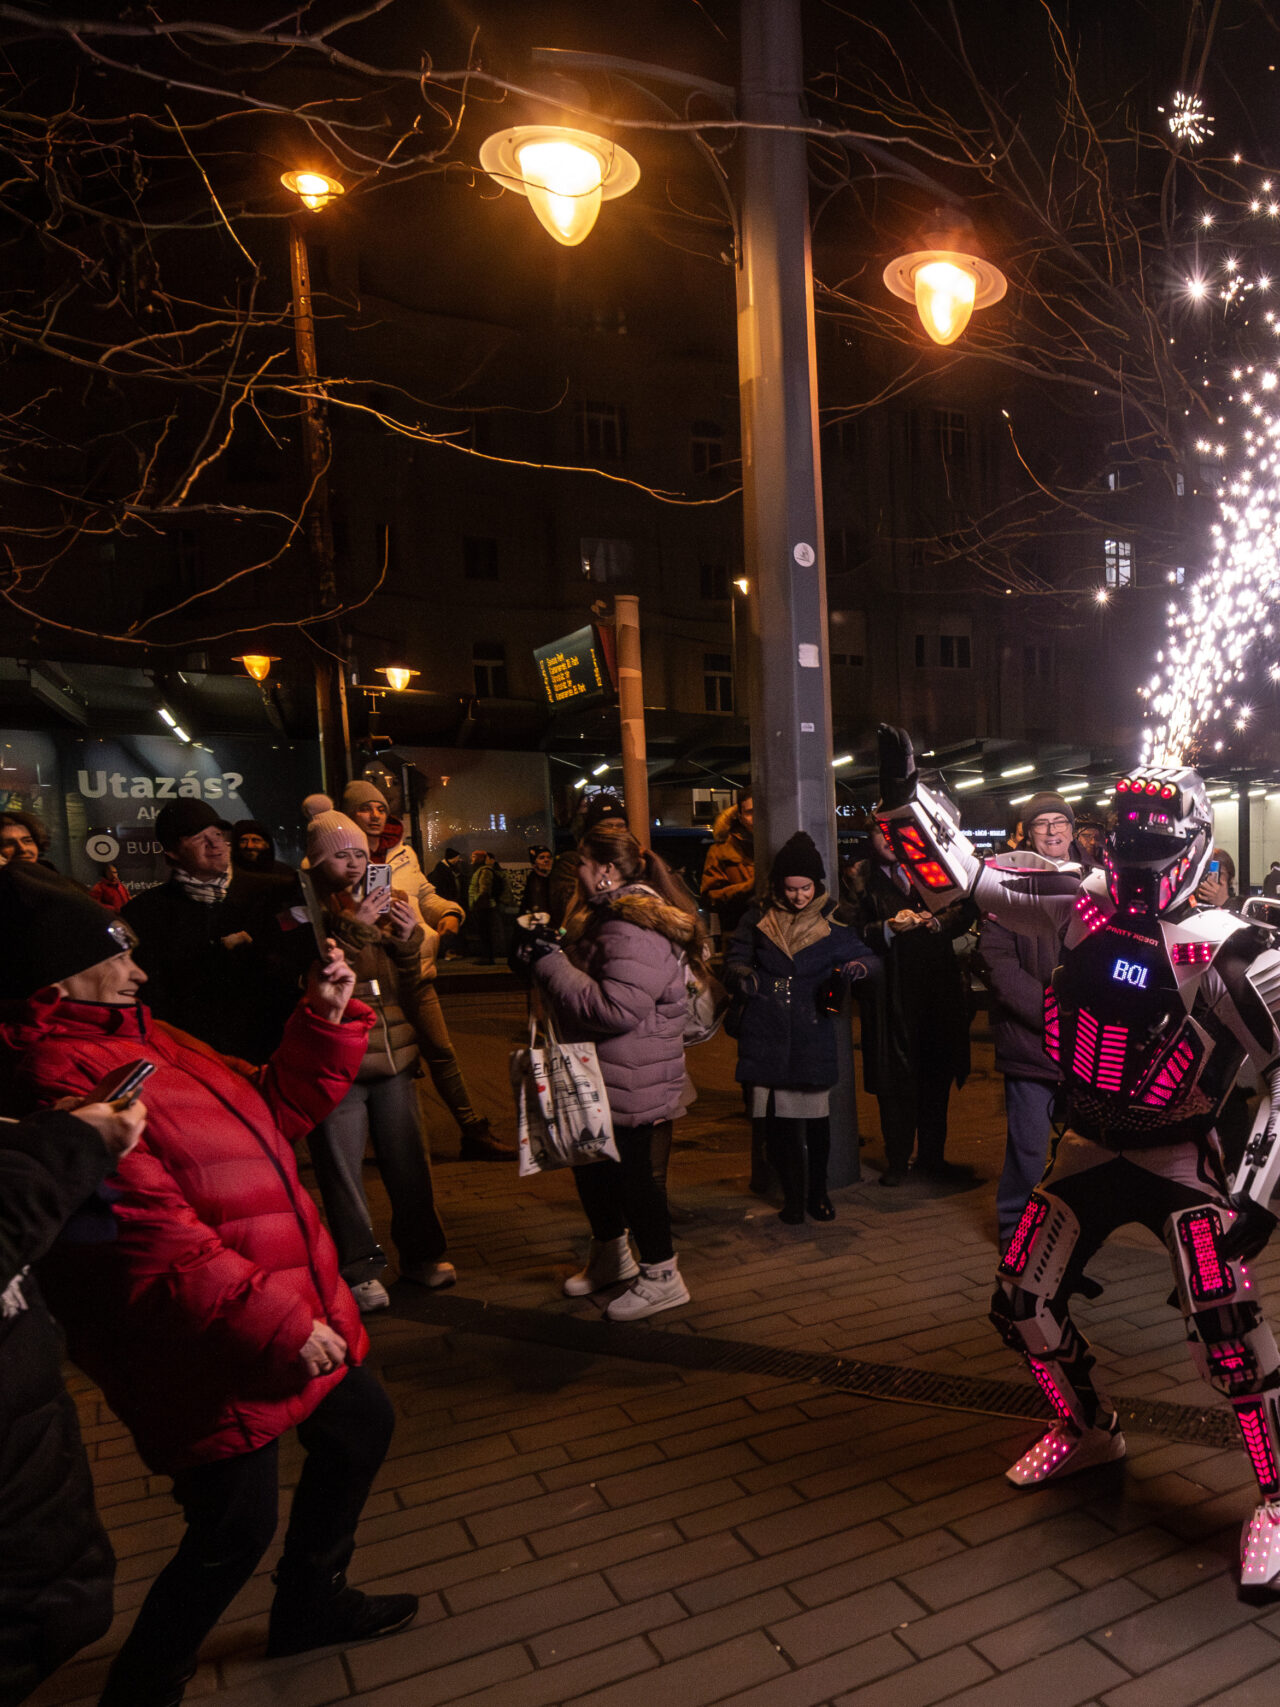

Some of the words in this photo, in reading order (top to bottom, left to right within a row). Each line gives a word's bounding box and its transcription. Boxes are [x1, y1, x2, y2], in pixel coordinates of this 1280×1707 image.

[77, 769, 244, 799] Utazás?
[1106, 925, 1131, 938] PARTY
[1133, 933, 1159, 947] ROBOT
[1112, 959, 1148, 988] BOL
